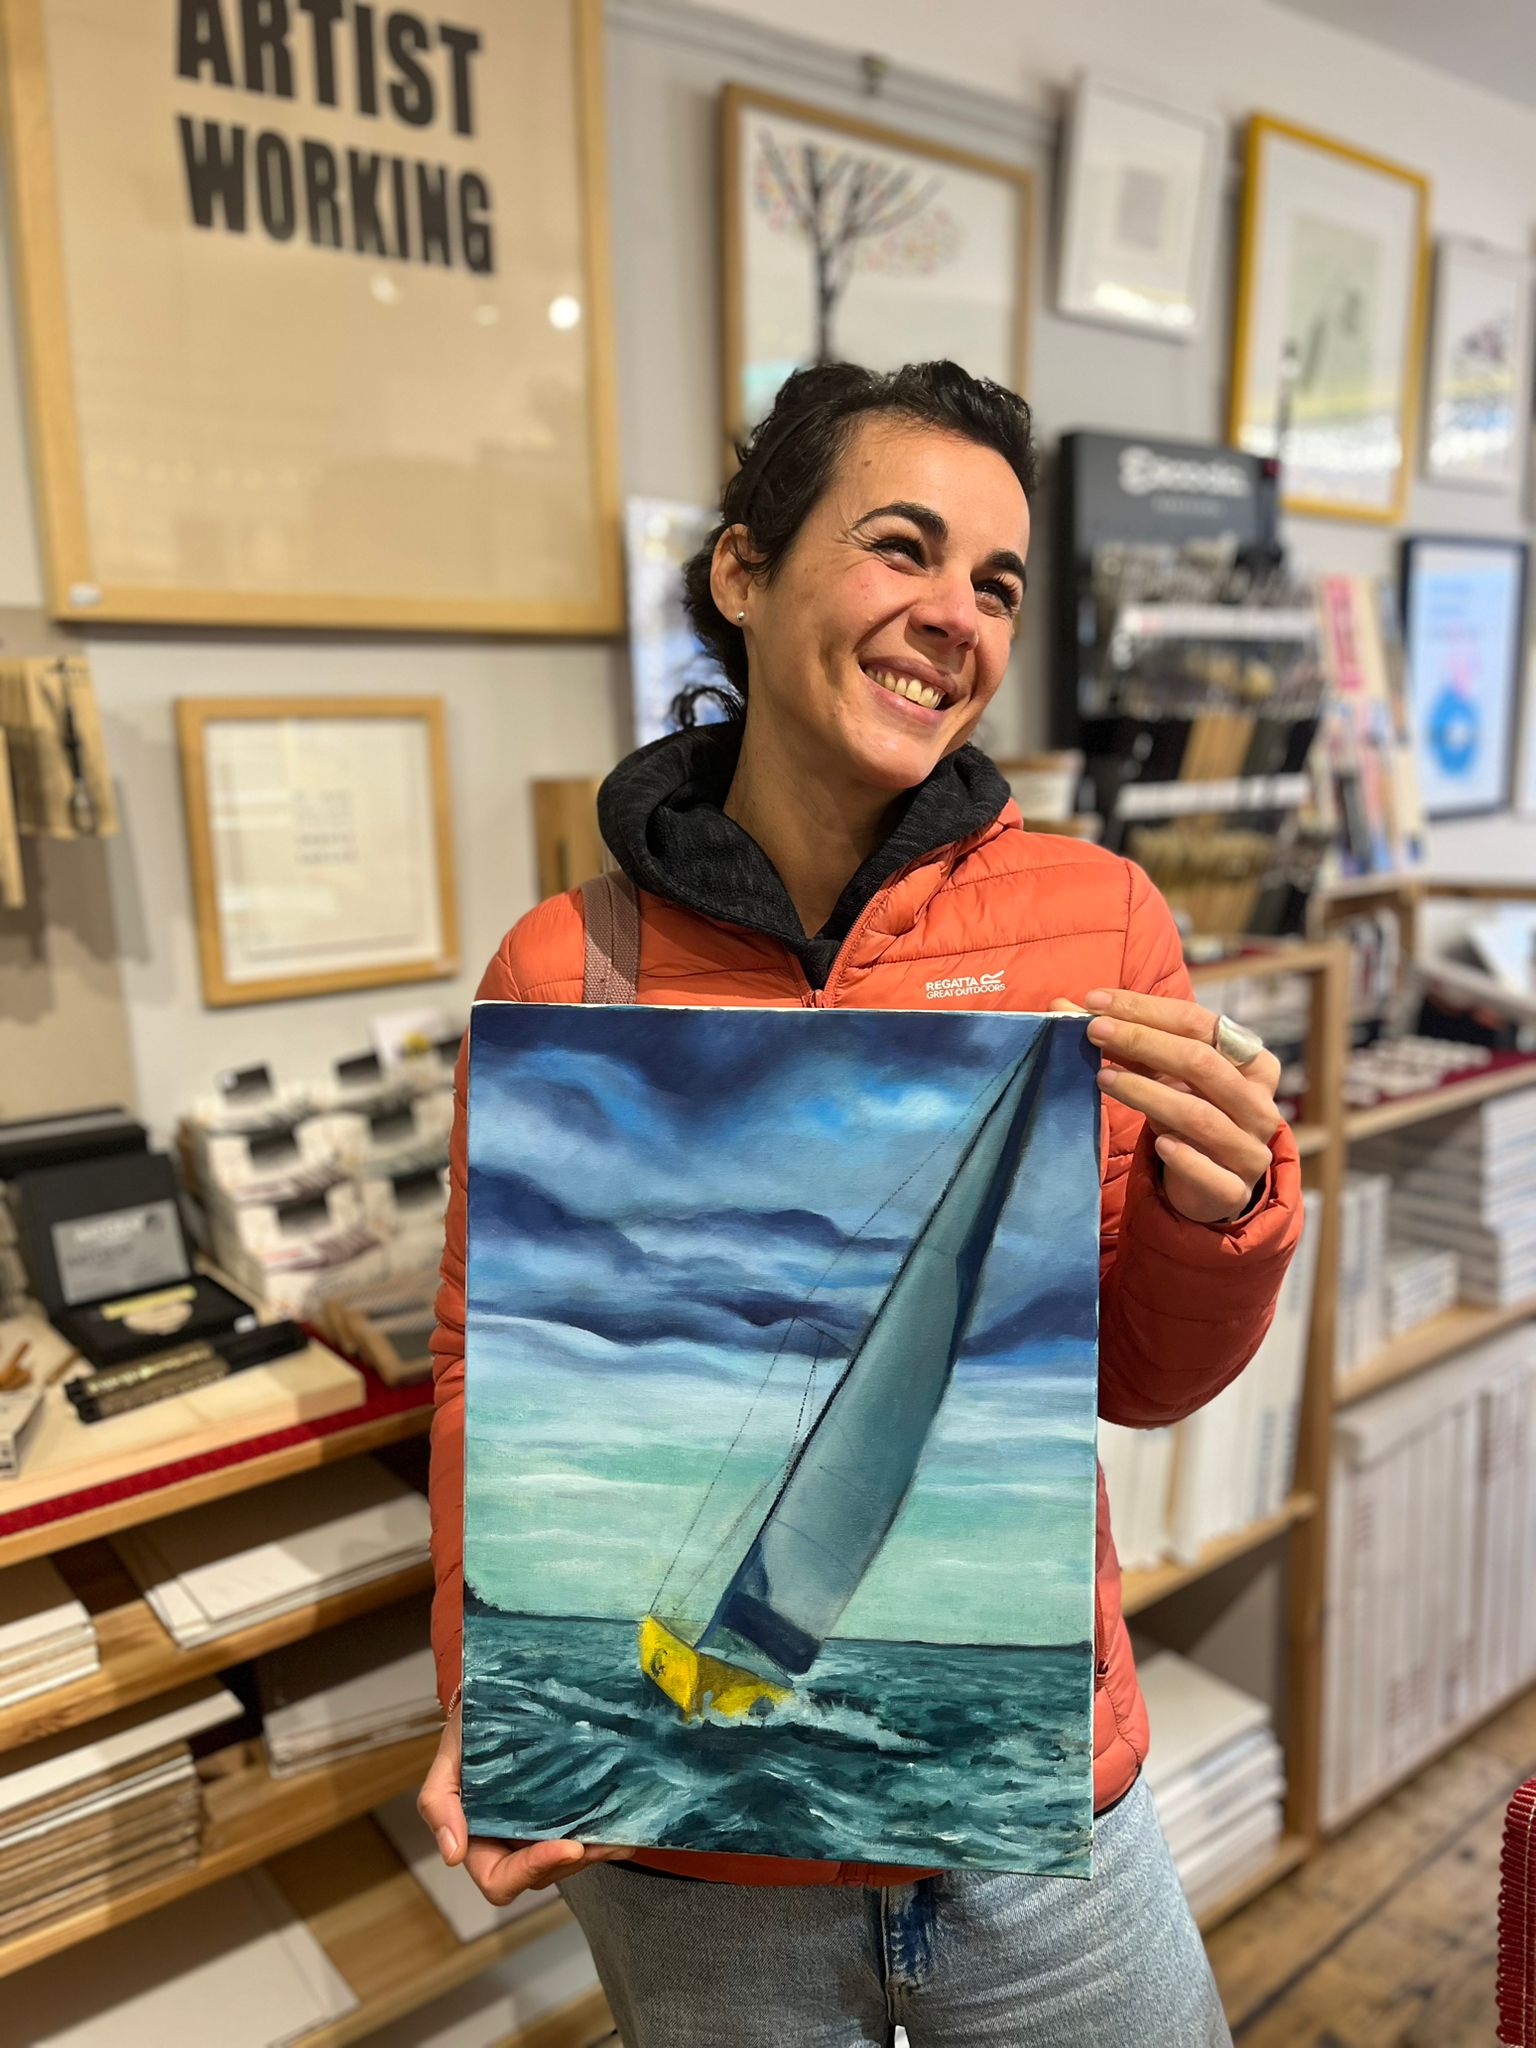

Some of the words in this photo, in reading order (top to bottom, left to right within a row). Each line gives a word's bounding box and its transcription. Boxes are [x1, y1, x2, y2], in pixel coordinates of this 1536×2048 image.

[176, 0, 482, 137] ARTIST
[176, 113, 494, 275] WORKING
[925, 976, 979, 992] REGATTA
[926, 988, 955, 999] GREAT
[954, 983, 1006, 997] OUTDOORS
